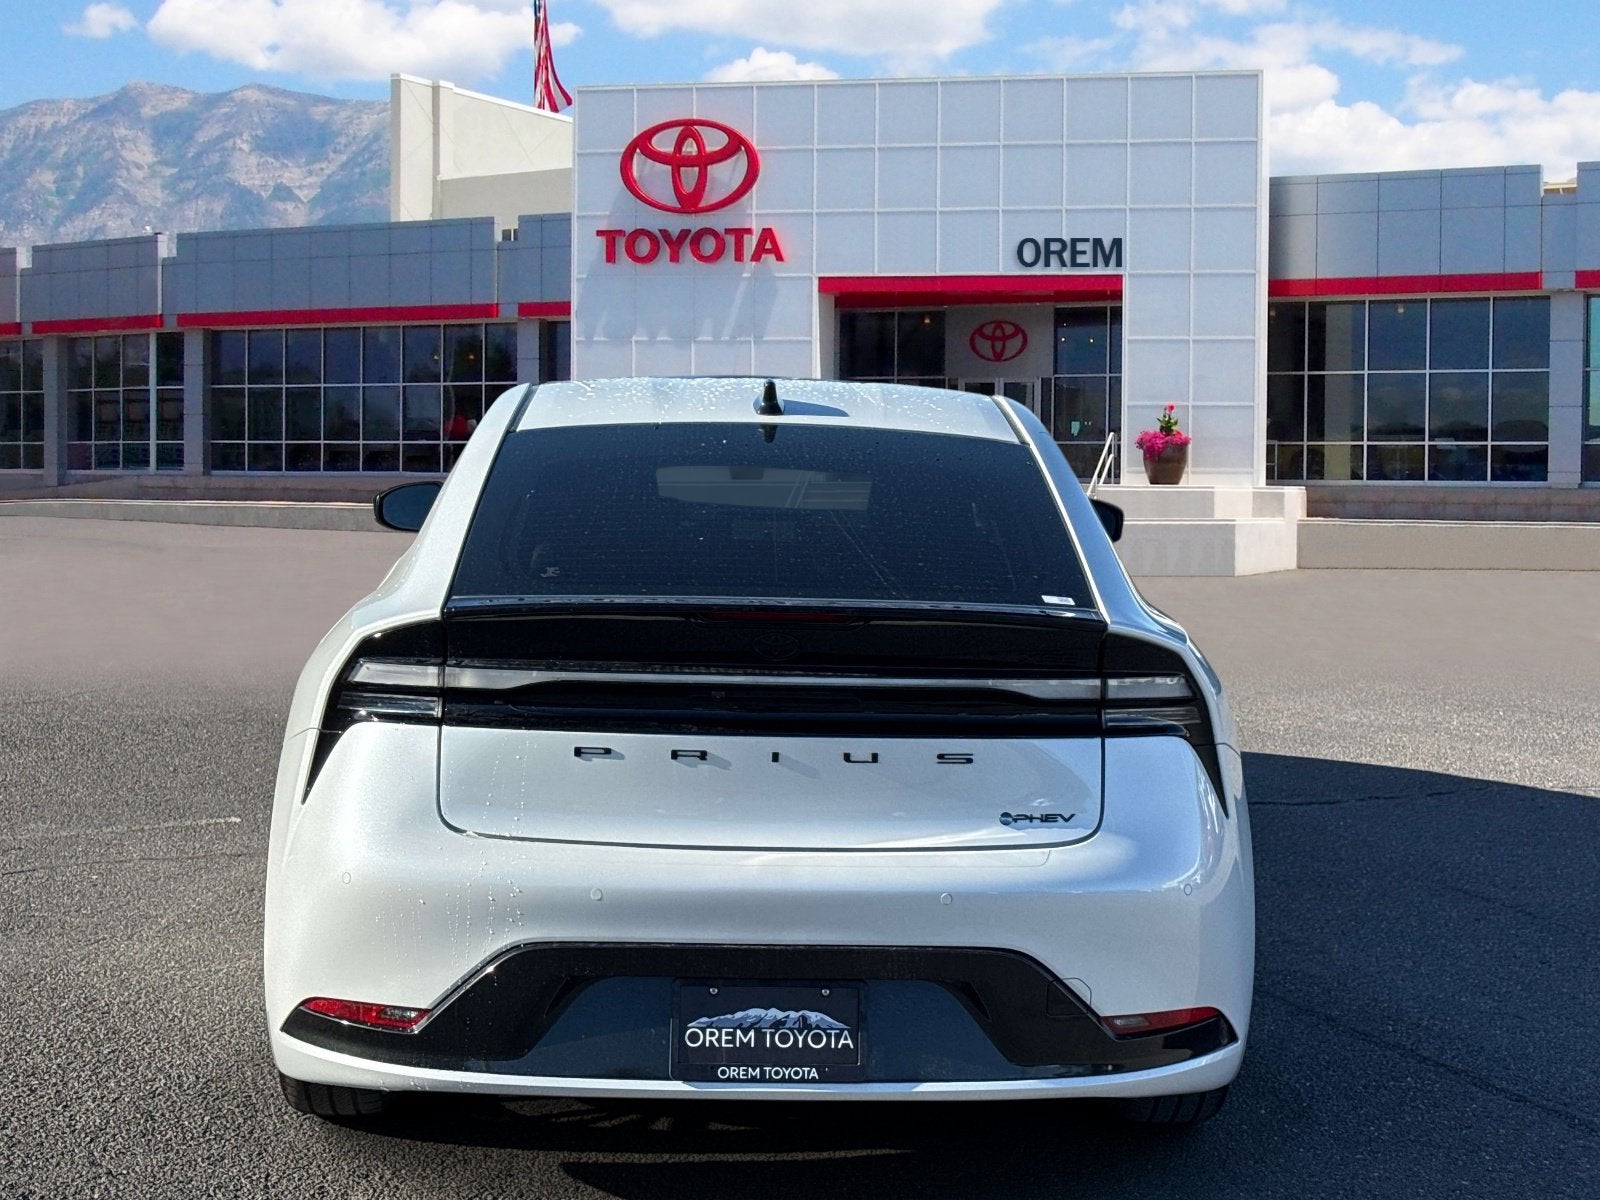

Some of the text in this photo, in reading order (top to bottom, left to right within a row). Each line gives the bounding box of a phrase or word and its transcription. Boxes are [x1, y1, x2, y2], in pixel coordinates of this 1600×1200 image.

[596, 227, 785, 264] TOYOTA
[1016, 237, 1122, 268] OREM
[574, 746, 973, 764] PRIUS
[1012, 813, 1076, 823] PHEV
[684, 1027, 854, 1049] OREM TOYOTA
[717, 1066, 819, 1080] OREM TOYOTA
